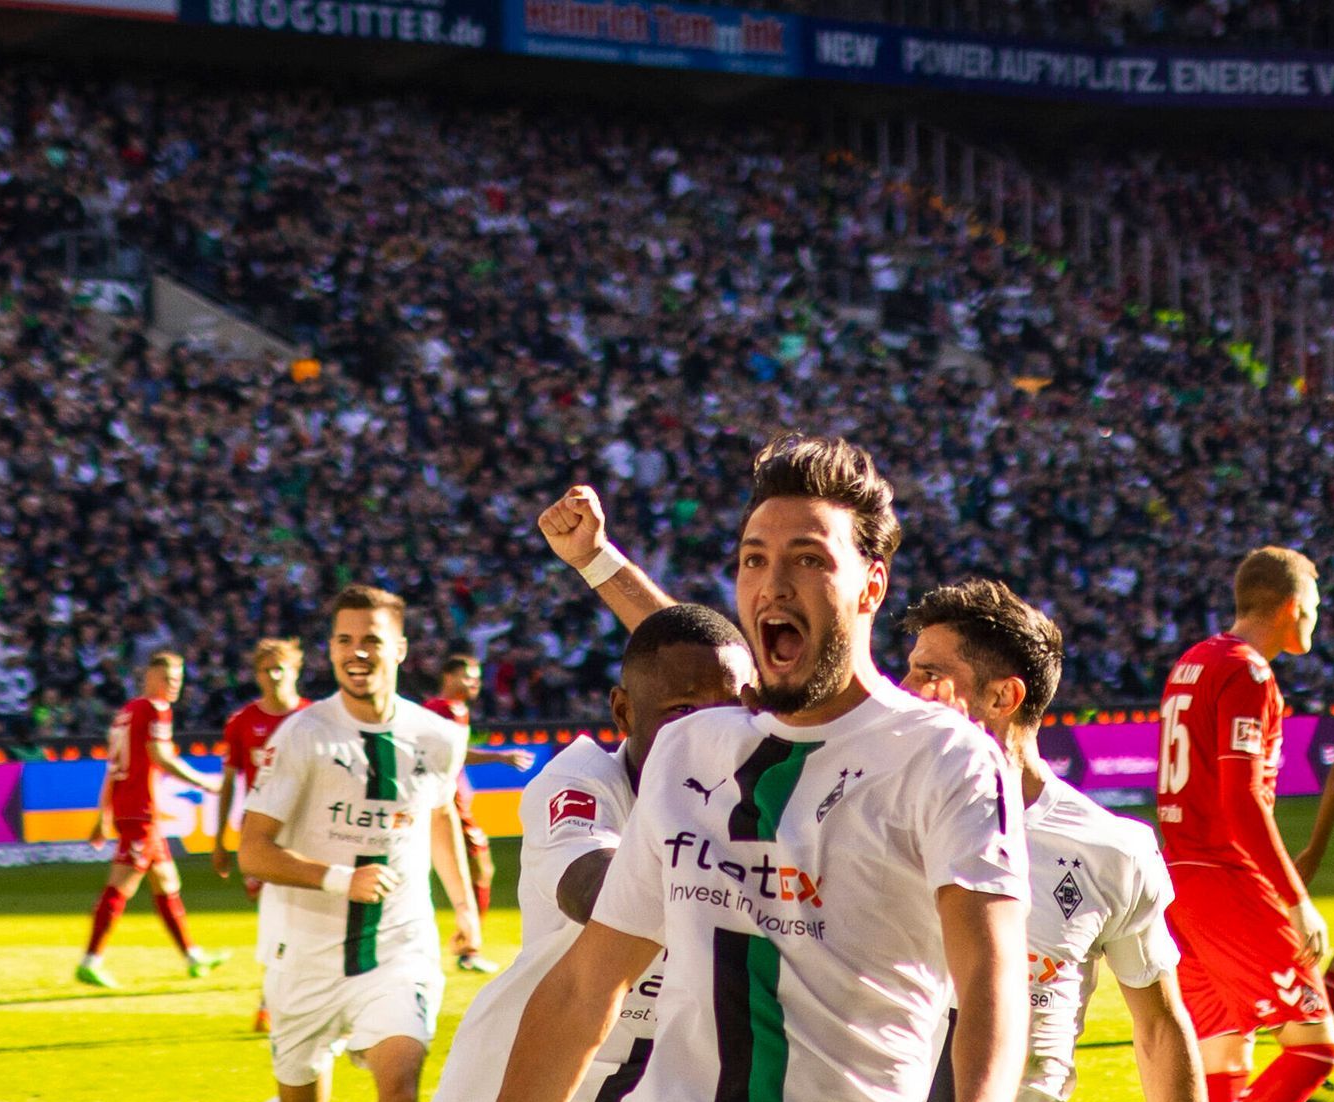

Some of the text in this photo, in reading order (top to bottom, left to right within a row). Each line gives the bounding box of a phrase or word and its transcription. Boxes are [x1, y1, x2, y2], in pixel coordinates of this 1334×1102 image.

[815, 30, 880, 69] NEW
[900, 36, 998, 79] POWER
[1170, 58, 1311, 97] ENERGIE
[1158, 694, 1194, 795] 15
[669, 881, 827, 941] Invest in yourself
